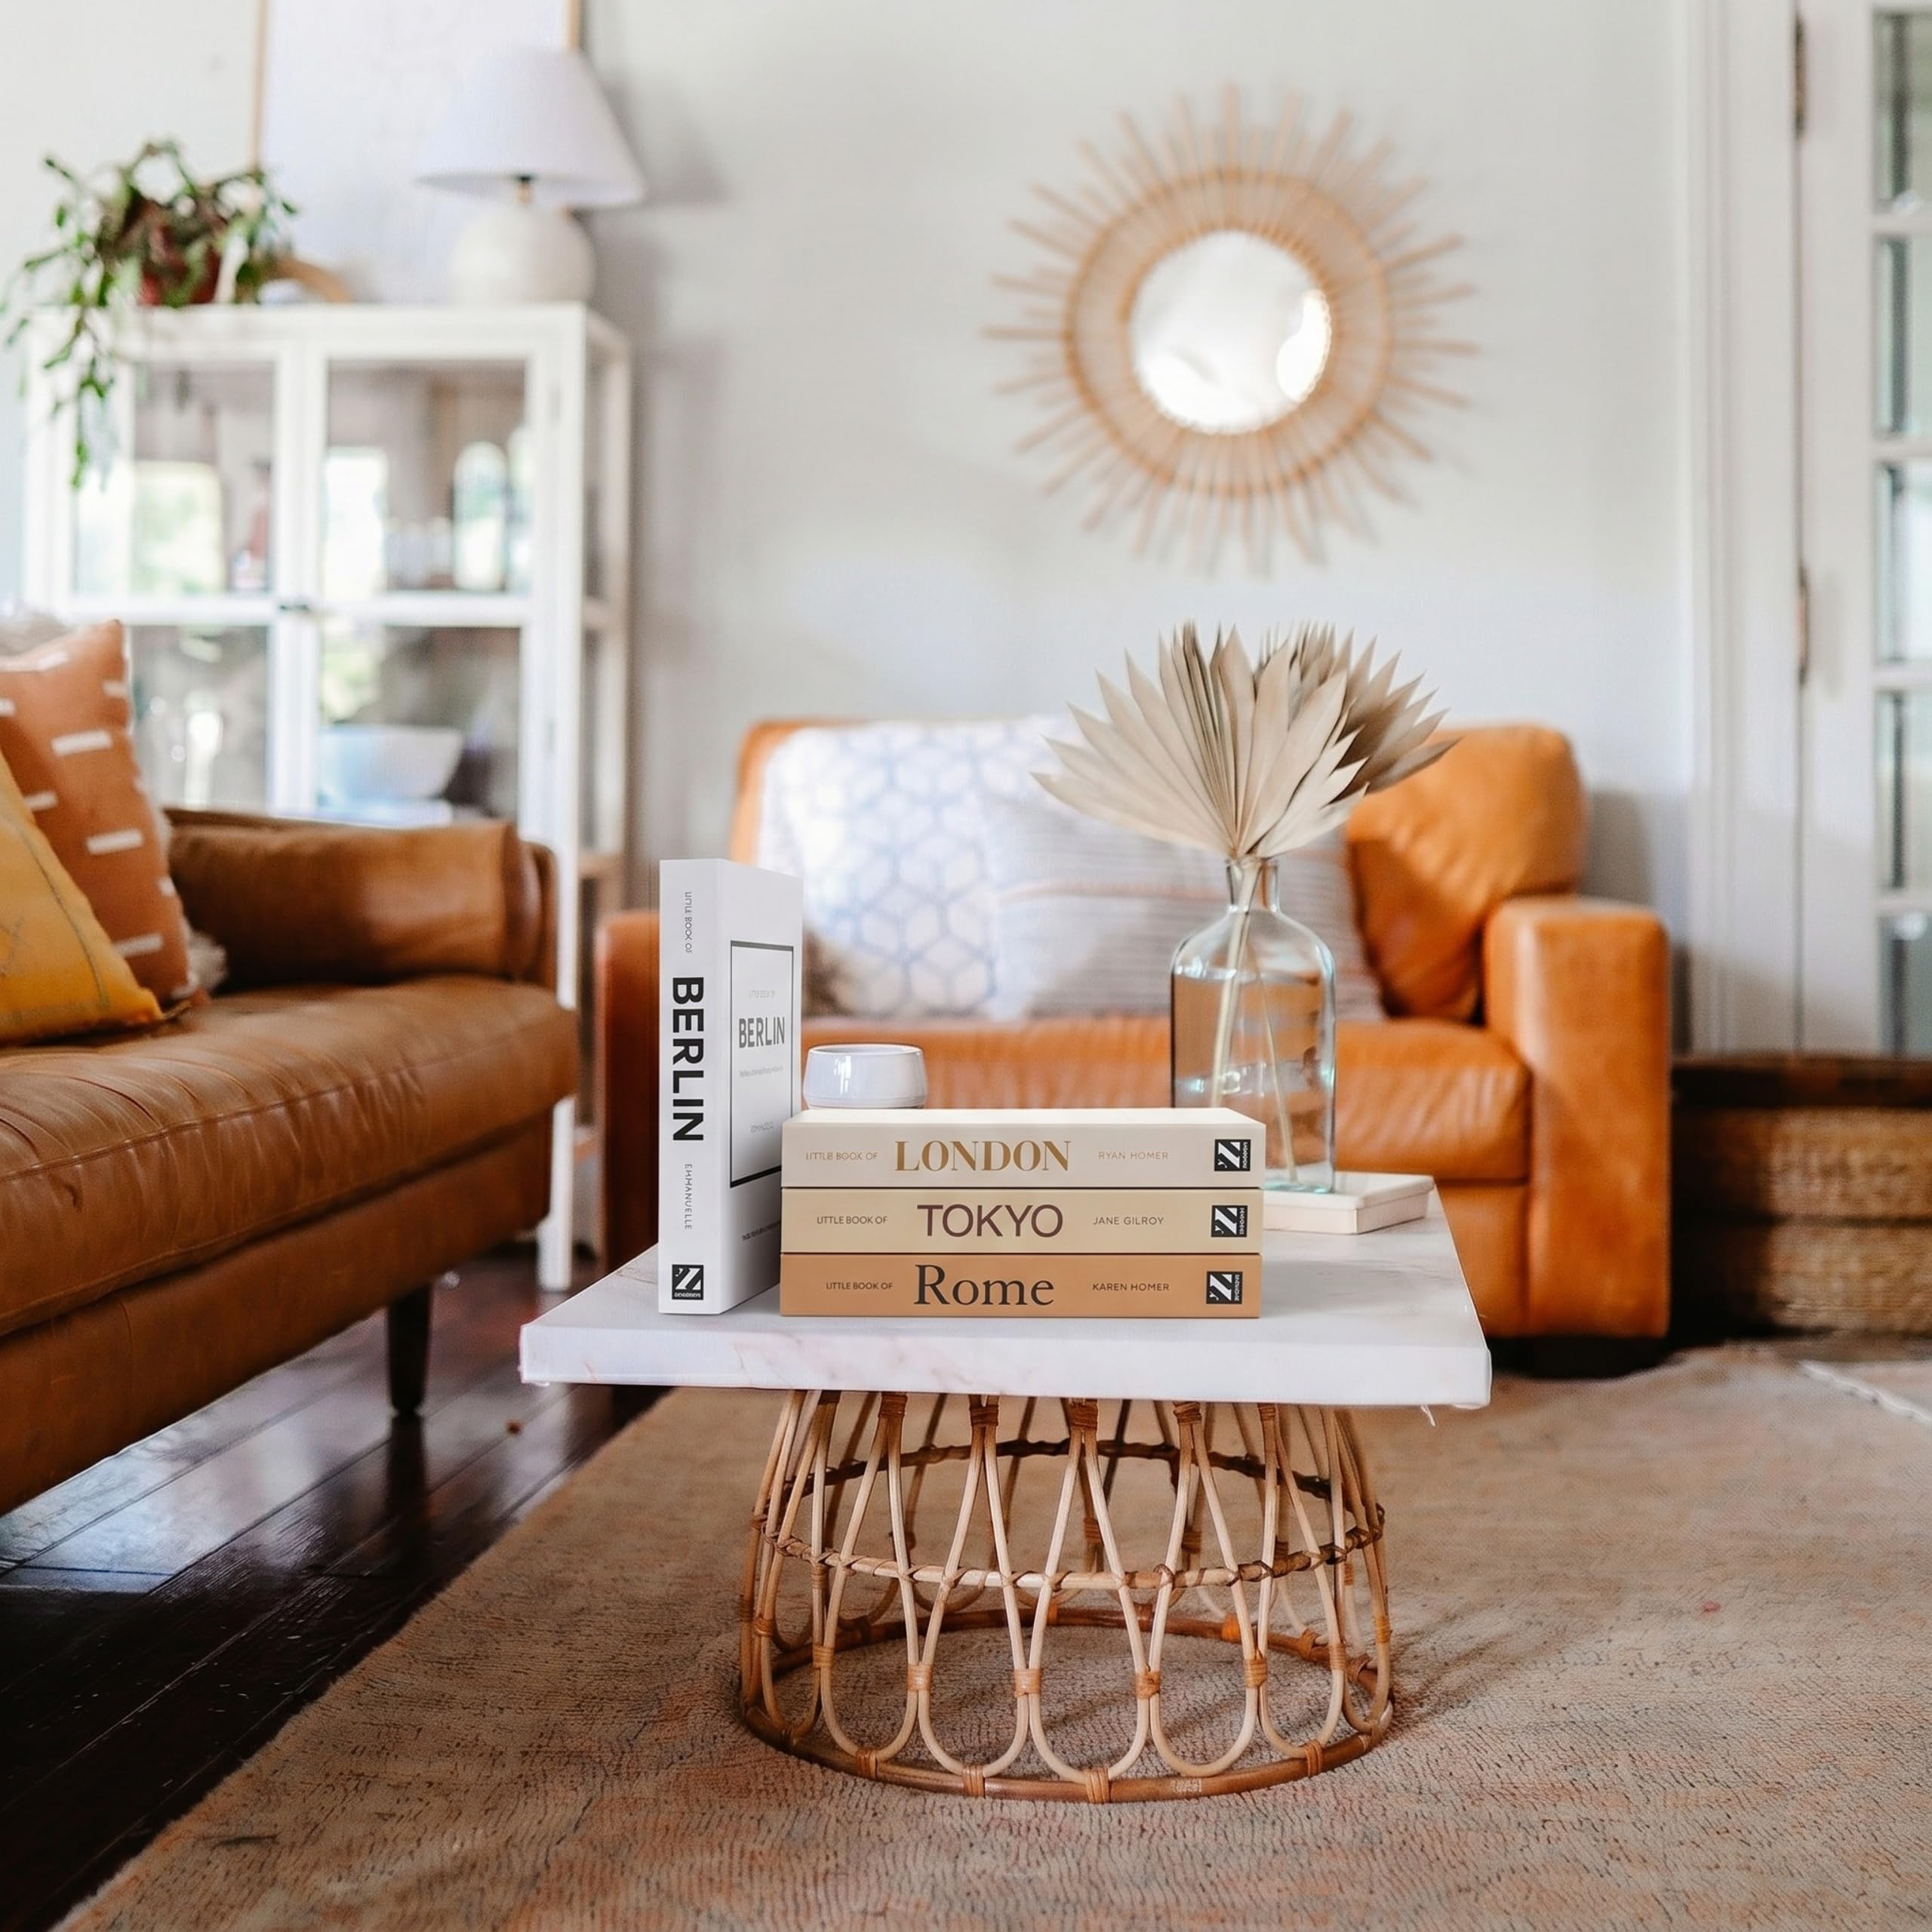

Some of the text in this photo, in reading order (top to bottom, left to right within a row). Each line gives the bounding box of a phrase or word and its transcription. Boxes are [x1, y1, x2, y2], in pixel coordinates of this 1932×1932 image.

[738, 1017, 785, 1049] BERLIN
[672, 977, 704, 1141] BERLIN
[805, 1152, 878, 1161] LITTLE BOOK OF
[894, 1140, 1071, 1172] LONDON
[1098, 1151, 1169, 1160] RYAN HOMER
[817, 1216, 888, 1225] LITTLE BOOK OF
[916, 1204, 1063, 1238] TOKYO
[1093, 1216, 1164, 1226] JANE GILROY
[826, 1281, 894, 1291] LITTLE BOOK OF
[913, 1264, 1054, 1306] Rome
[1092, 1283, 1171, 1291] KAREN HOMER
